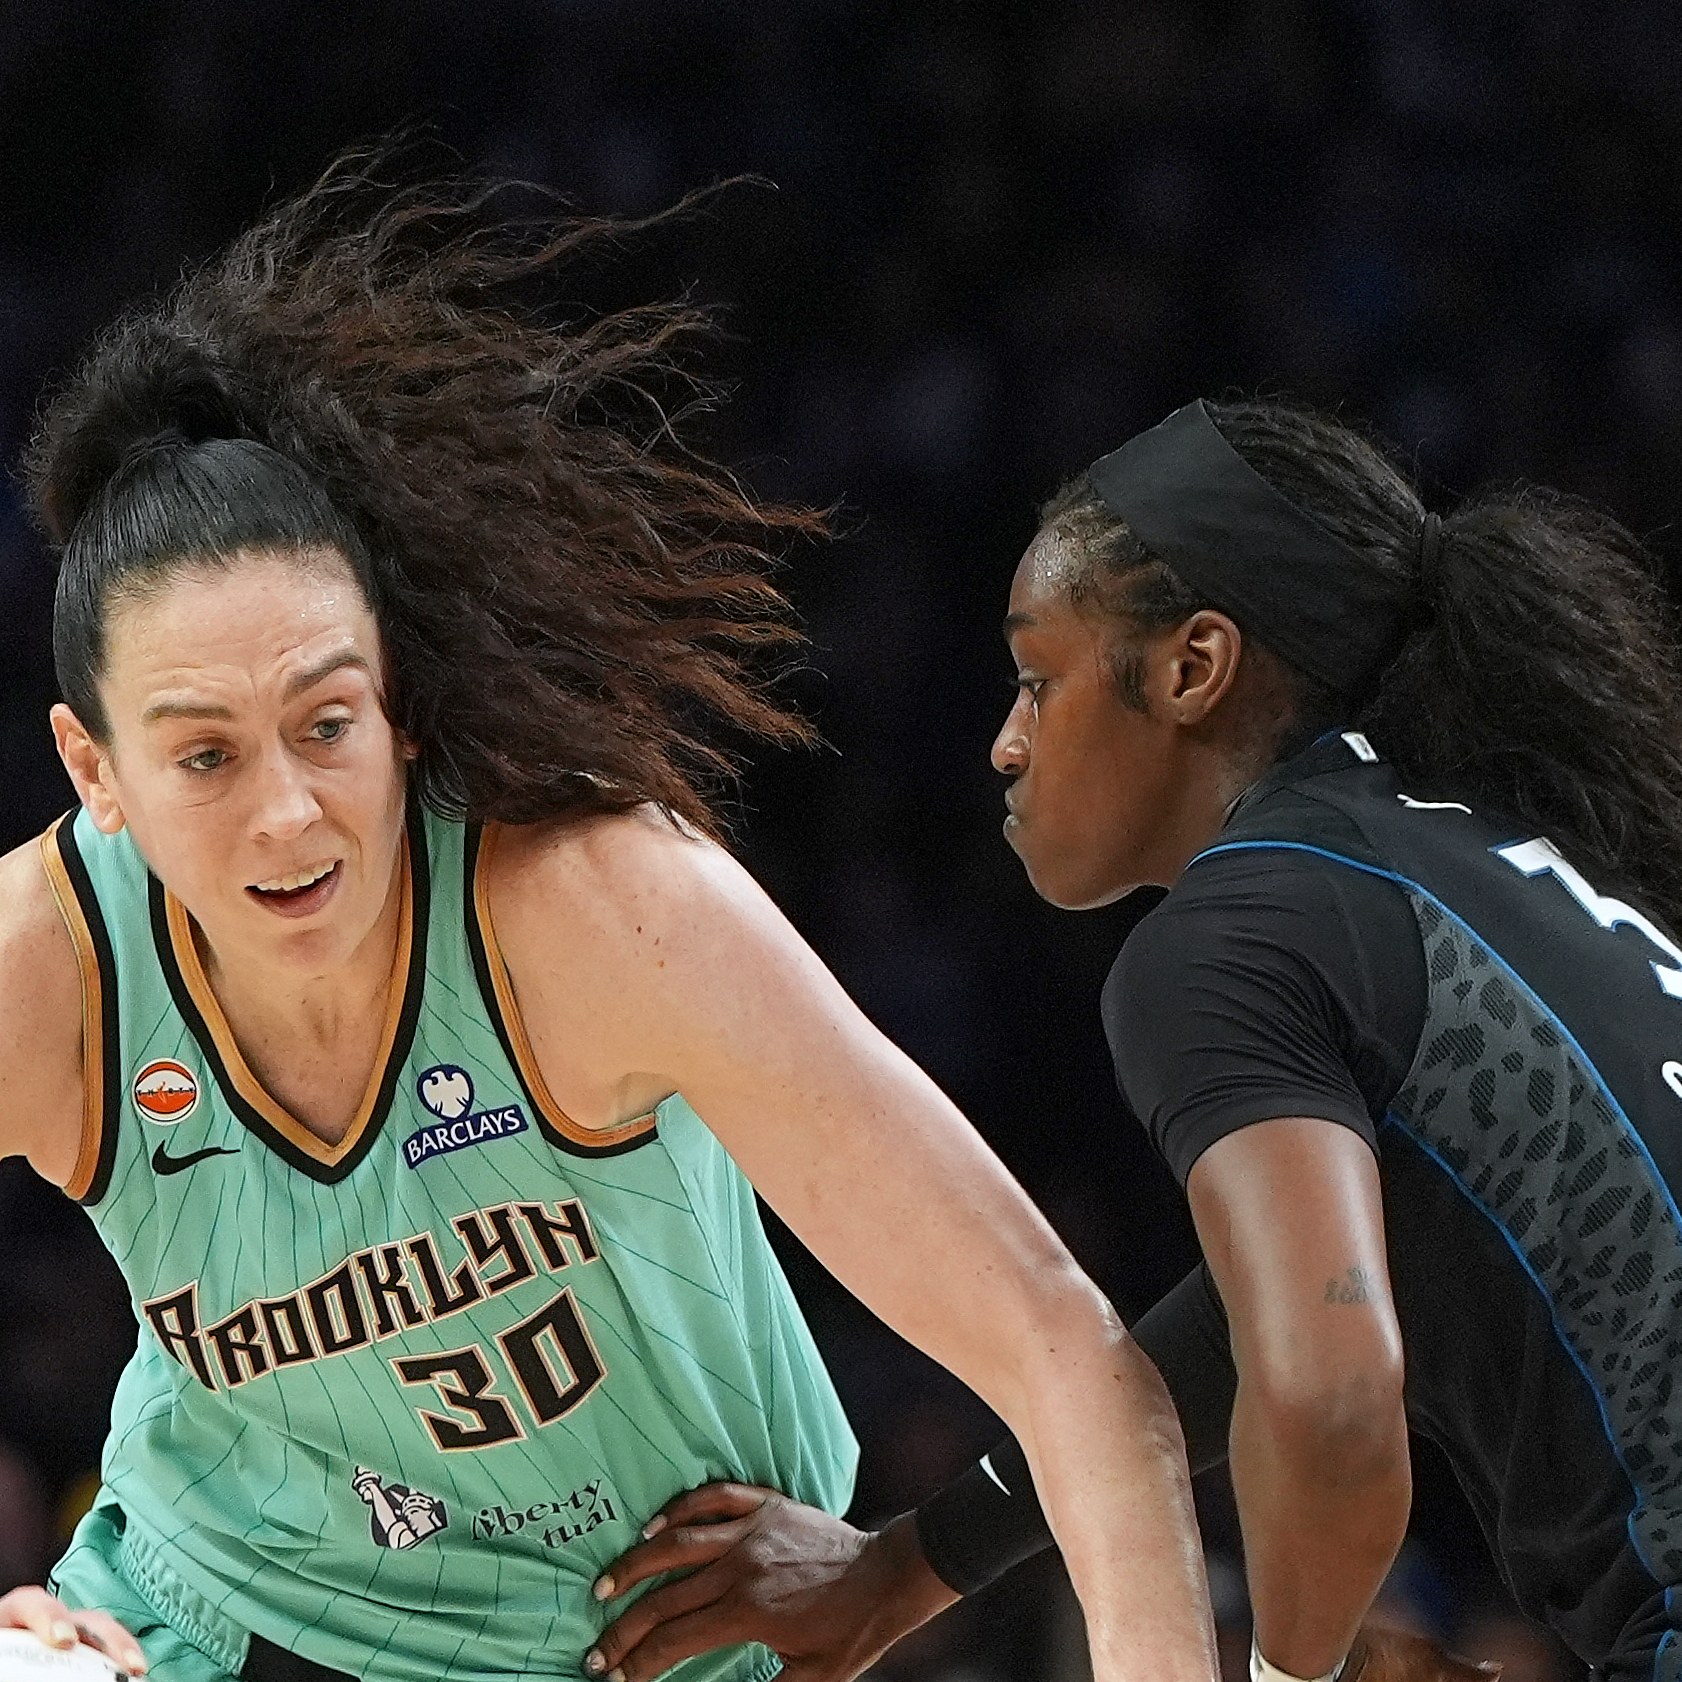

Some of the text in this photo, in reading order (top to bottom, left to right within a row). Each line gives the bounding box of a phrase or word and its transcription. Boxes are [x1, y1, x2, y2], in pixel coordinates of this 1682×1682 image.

[407, 1108, 521, 1164] BARCLAYS
[141, 1197, 600, 1394] BROOKLYN
[388, 1283, 609, 1454] 30
[541, 1498, 618, 1550] tual
